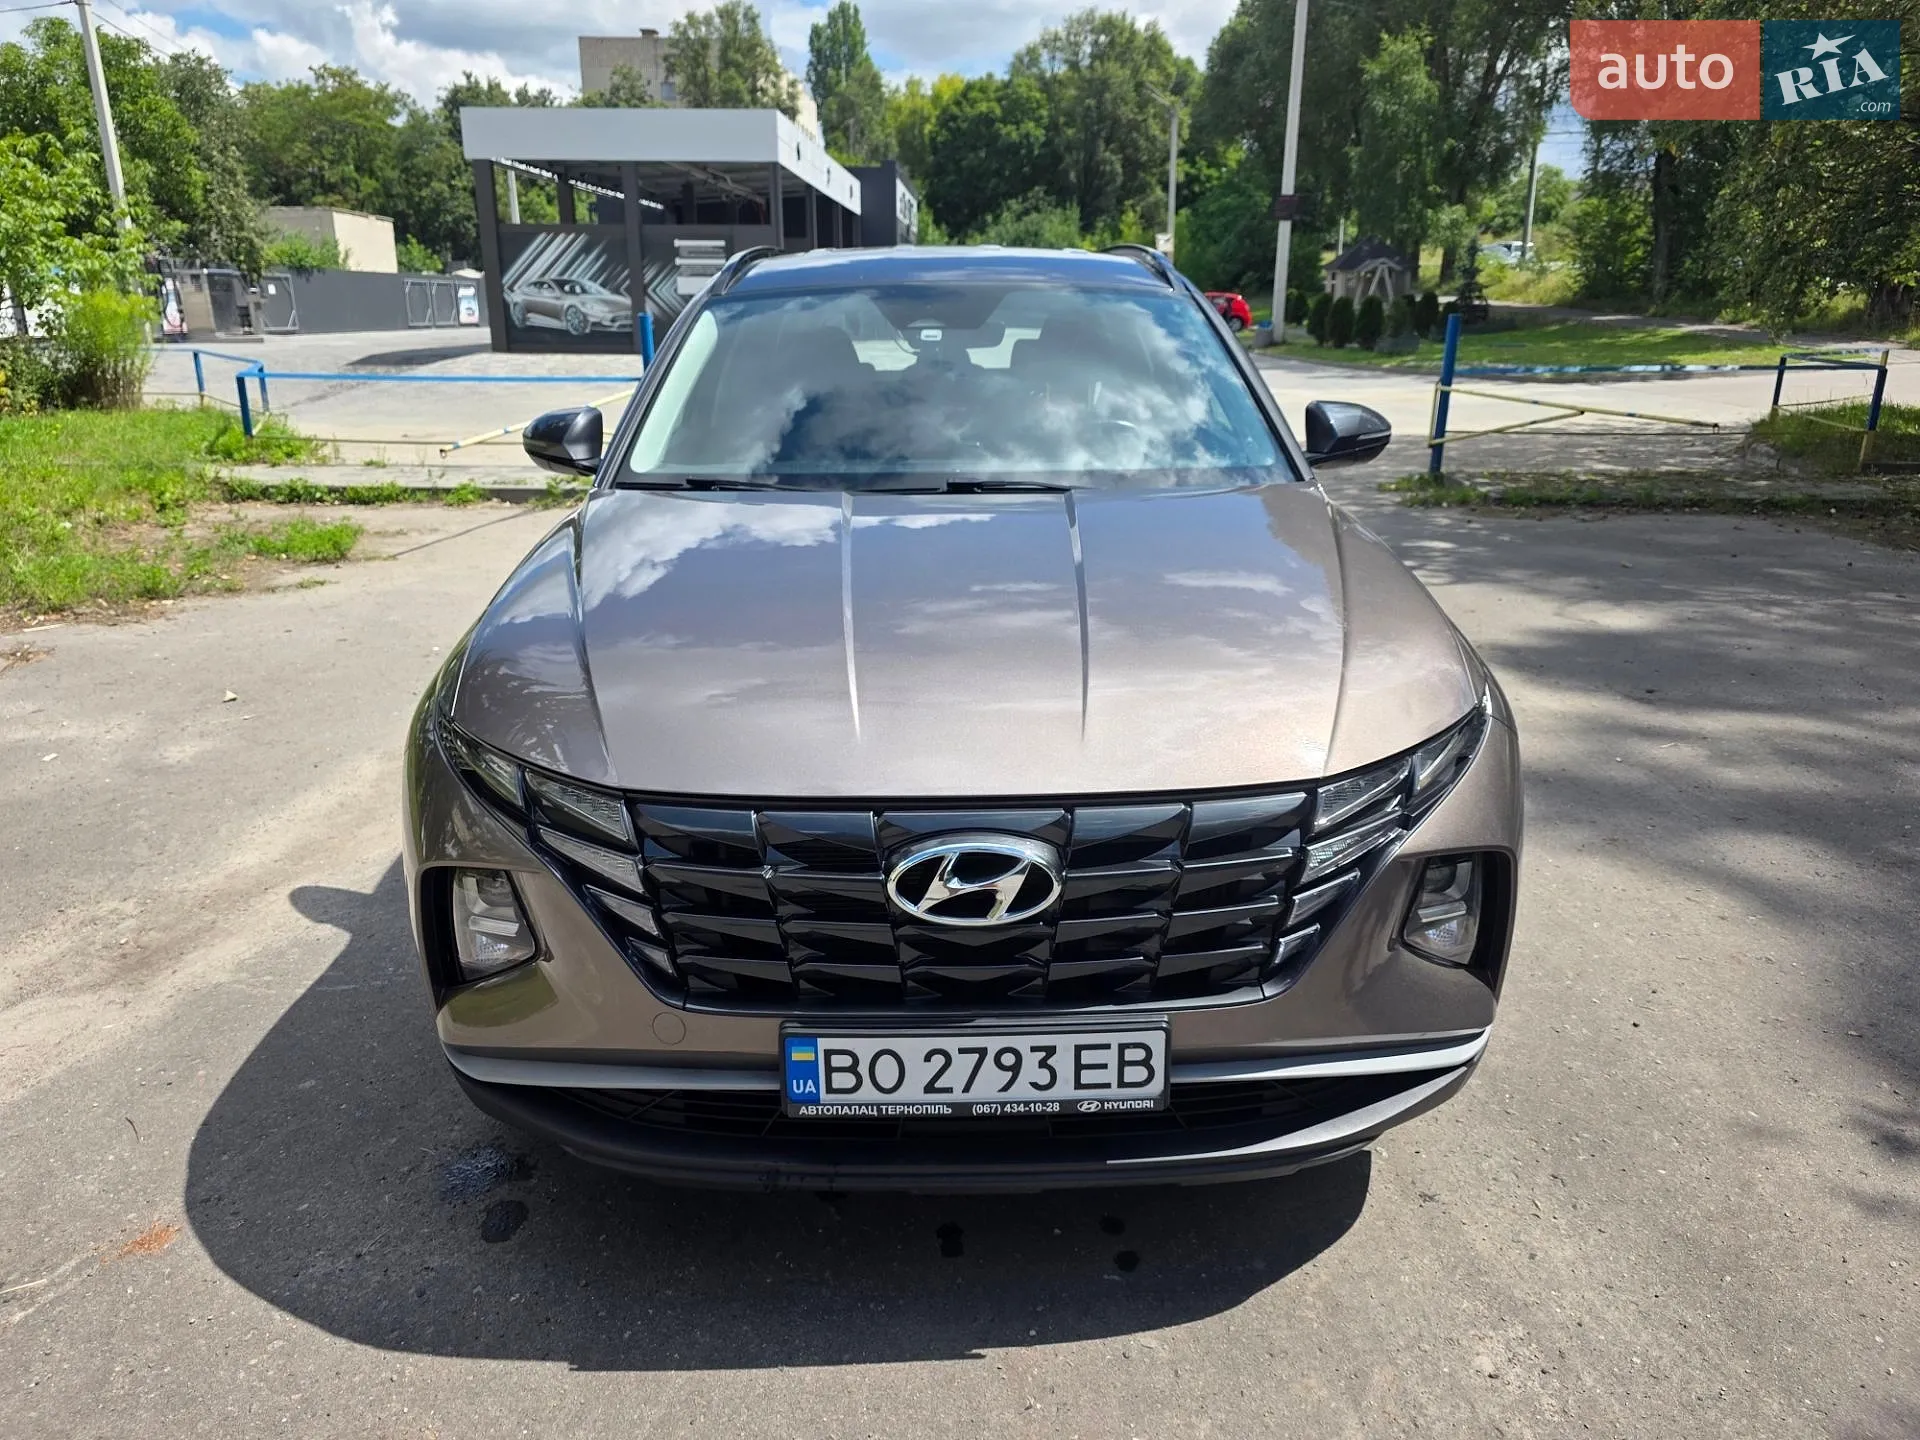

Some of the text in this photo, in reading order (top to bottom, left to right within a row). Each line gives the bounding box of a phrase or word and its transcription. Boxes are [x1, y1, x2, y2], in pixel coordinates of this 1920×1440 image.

[824, 1042, 1155, 1094] BO 2793 EB
[793, 1080, 816, 1093] UA
[799, 1099, 1154, 1117] АВТОПАЛАЦ ТЕРНОПІЛЬ (067) 434-10-28 HYUNDAI
